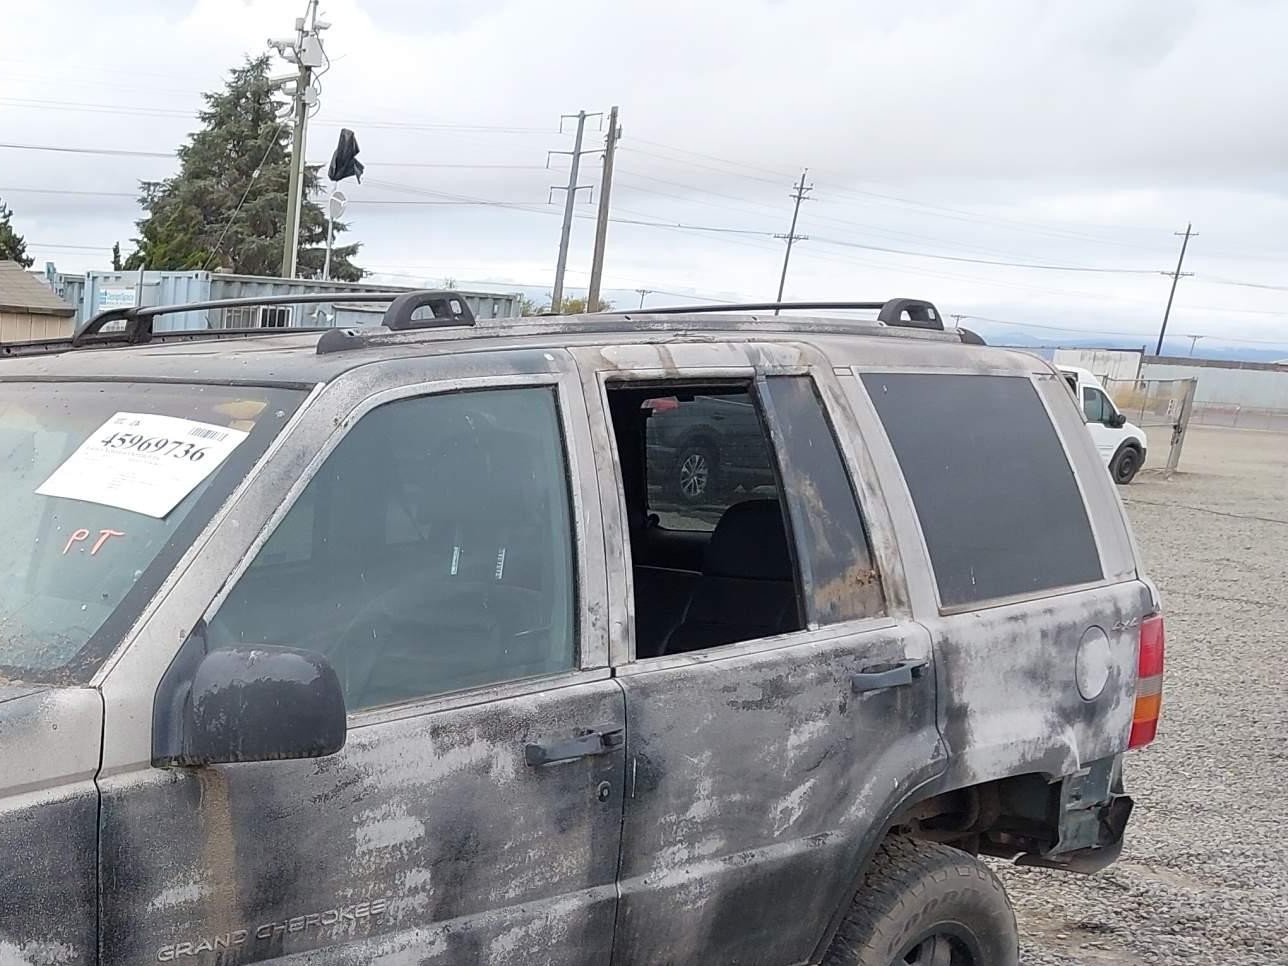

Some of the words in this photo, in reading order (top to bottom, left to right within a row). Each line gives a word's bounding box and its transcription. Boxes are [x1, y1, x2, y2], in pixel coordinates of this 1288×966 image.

[101, 432, 211, 462] 45969736
[157, 929, 248, 962] GRAND
[255, 900, 386, 940] CHEROKEE
